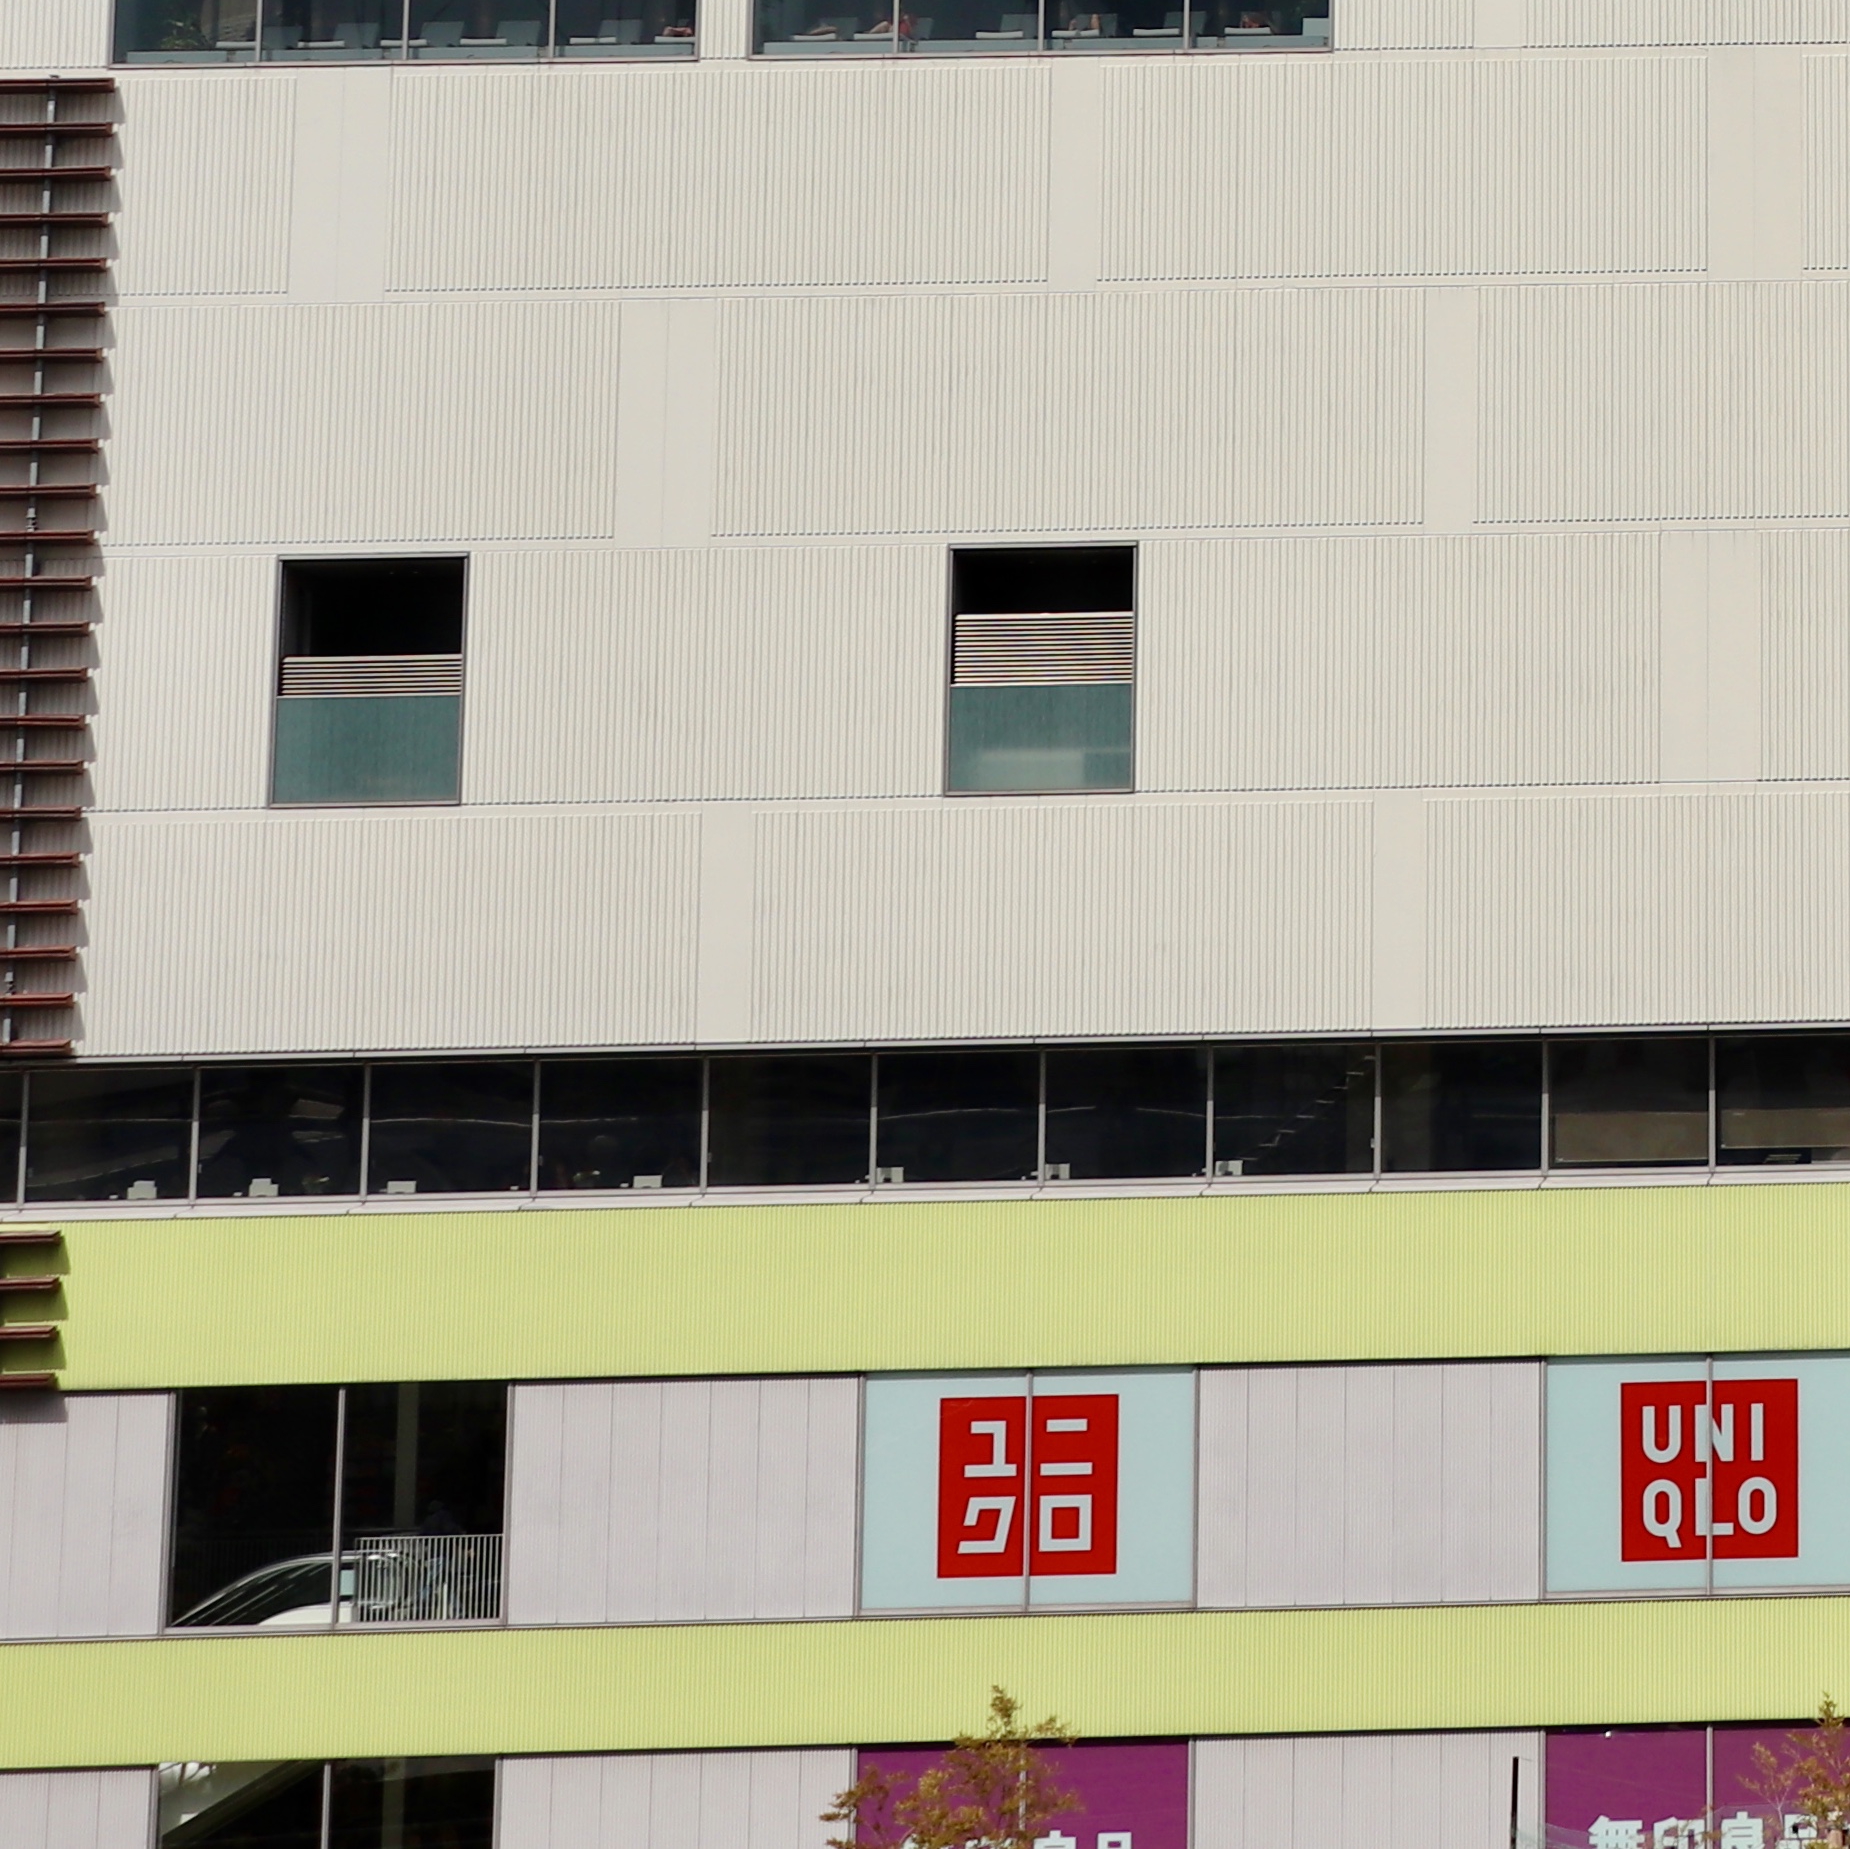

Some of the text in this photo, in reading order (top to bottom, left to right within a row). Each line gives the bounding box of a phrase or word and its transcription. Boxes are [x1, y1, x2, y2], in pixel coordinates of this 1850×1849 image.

[963, 1418, 1093, 1478] ユニ
[1642, 1402, 1764, 1464] UNI
[957, 1494, 1092, 1554] クロ
[1642, 1476, 1777, 1548] QLO
